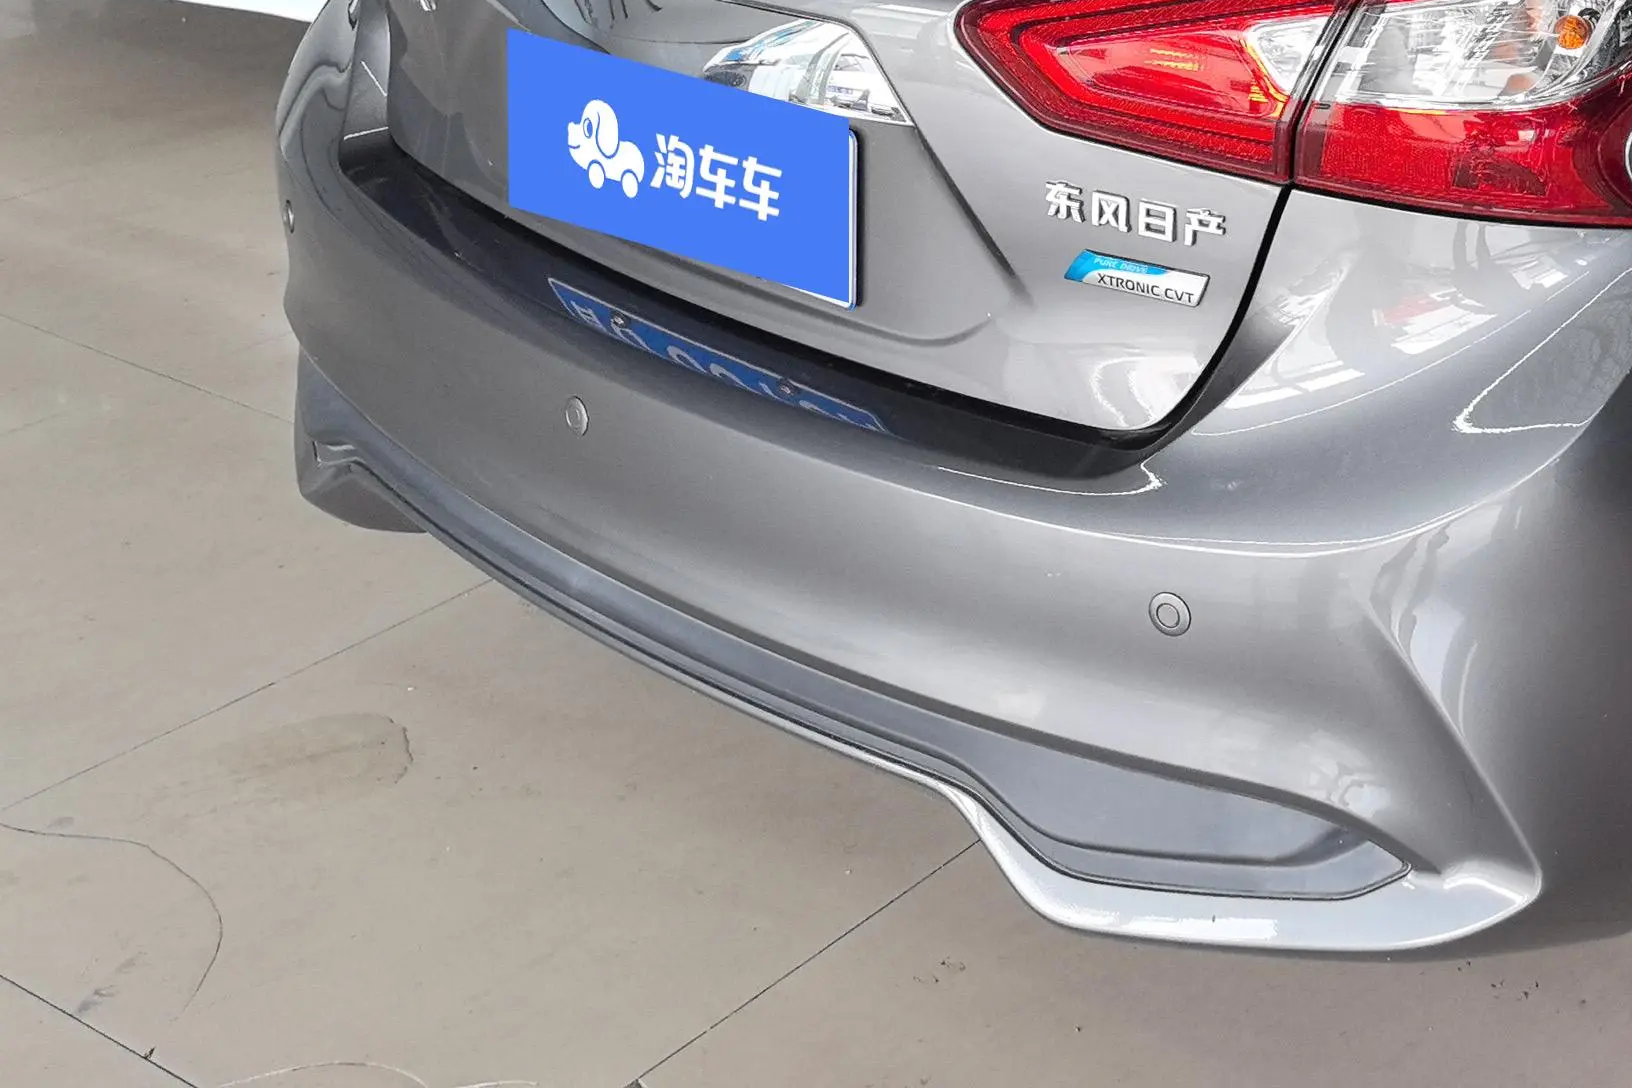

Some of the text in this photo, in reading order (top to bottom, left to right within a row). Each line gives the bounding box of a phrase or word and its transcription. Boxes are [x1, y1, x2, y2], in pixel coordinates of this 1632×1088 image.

[1045, 180, 1226, 247] 东风日产
[1096, 272, 1194, 304] XTRONIC CVT
